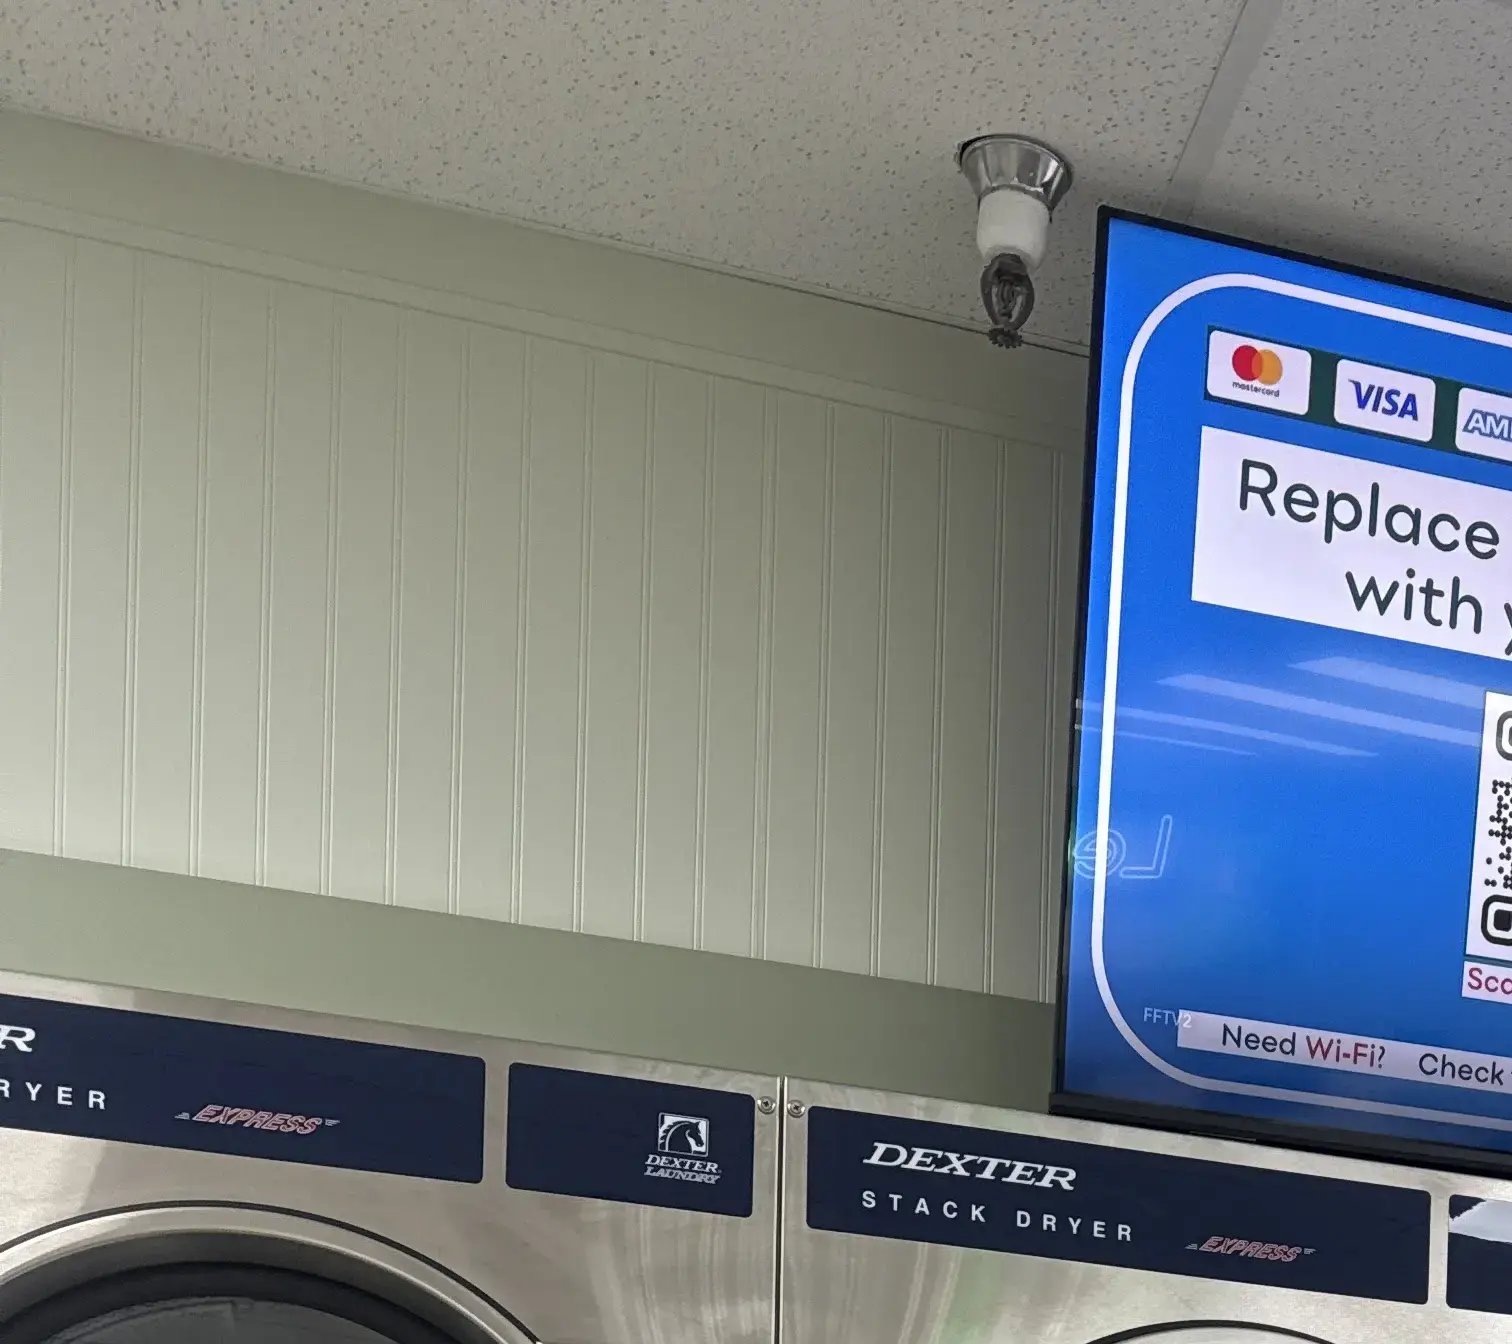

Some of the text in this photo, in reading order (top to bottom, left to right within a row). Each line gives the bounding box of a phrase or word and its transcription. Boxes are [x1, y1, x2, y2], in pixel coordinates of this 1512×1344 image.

[1233, 380, 1280, 398] mastercard
[1348, 379, 1419, 421] VISA
[1239, 459, 1499, 560] Replace
[1346, 568, 1482, 635] with
[1143, 1007, 1192, 1028] FFTV2
[1222, 1023, 1296, 1056] Need
[1306, 1035, 1386, 1069] Wi-Fi?
[1418, 1052, 1504, 1086] Check
[0, 1079, 106, 1110] RYER
[192, 1104, 322, 1134] EXPRESS
[644, 1166, 721, 1184] LAUNDRY
[645, 1154, 719, 1174] DEXTER
[862, 1141, 1077, 1191] DEXTER
[862, 1191, 1132, 1242] STACK DRYER
[1199, 1236, 1301, 1262] EXPRESS
